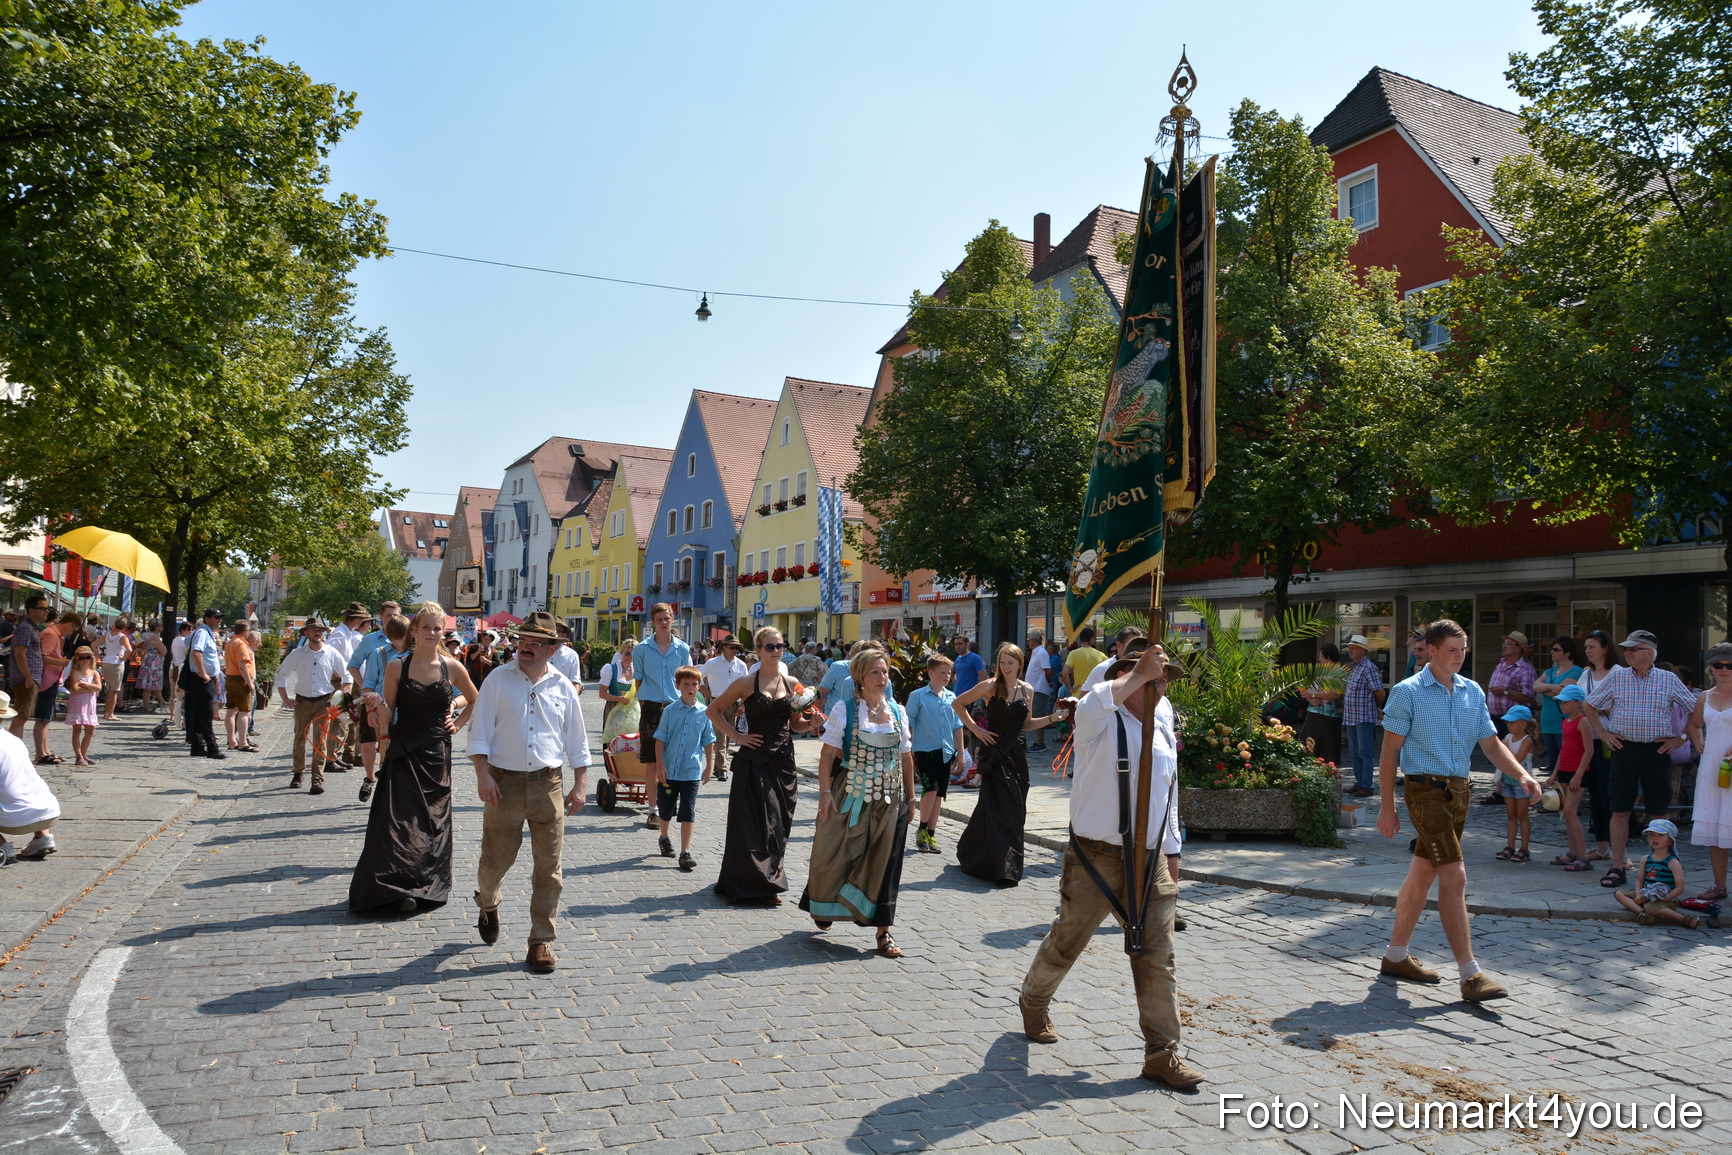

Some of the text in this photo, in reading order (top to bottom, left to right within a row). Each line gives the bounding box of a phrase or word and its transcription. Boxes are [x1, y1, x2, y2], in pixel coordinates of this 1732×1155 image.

[1089, 486, 1149, 518] Leben
[569, 558, 581, 569] HOTEL
[755, 604, 763, 617] P
